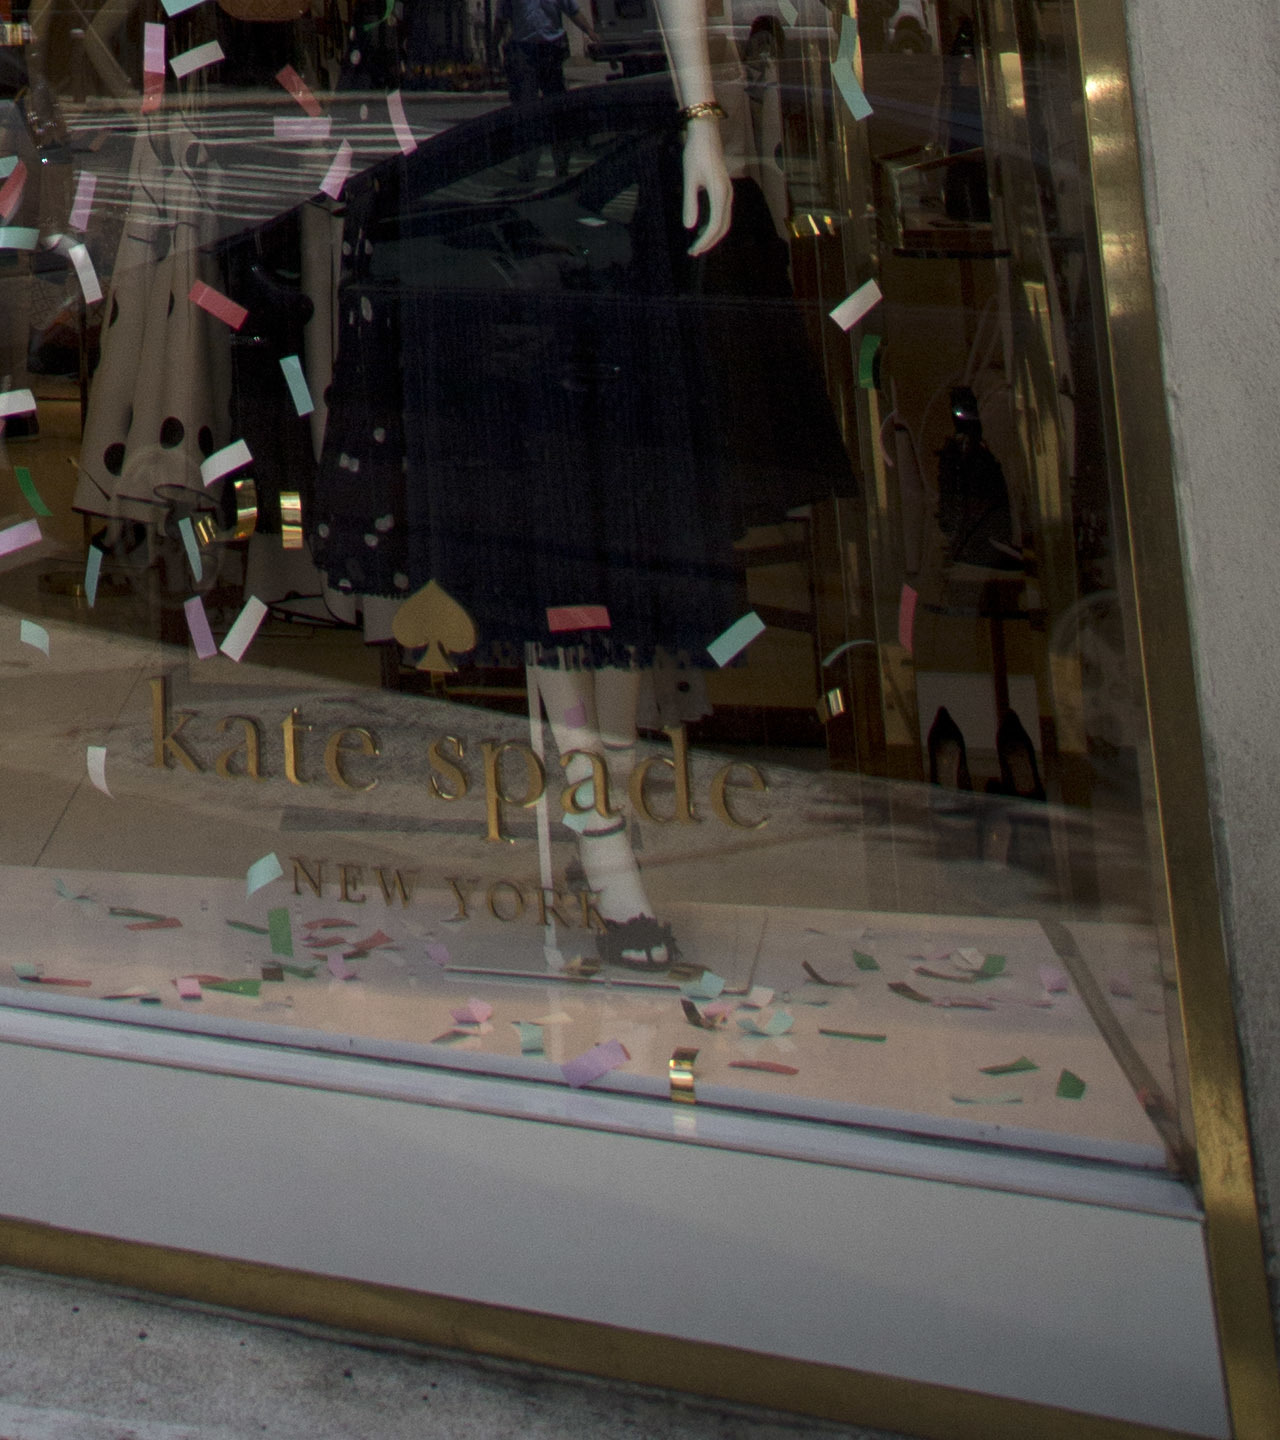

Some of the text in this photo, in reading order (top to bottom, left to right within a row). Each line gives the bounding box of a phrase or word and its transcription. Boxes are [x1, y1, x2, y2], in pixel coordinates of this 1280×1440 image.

[148, 675, 769, 844] kate spade
[288, 855, 610, 935] NEW YORK
